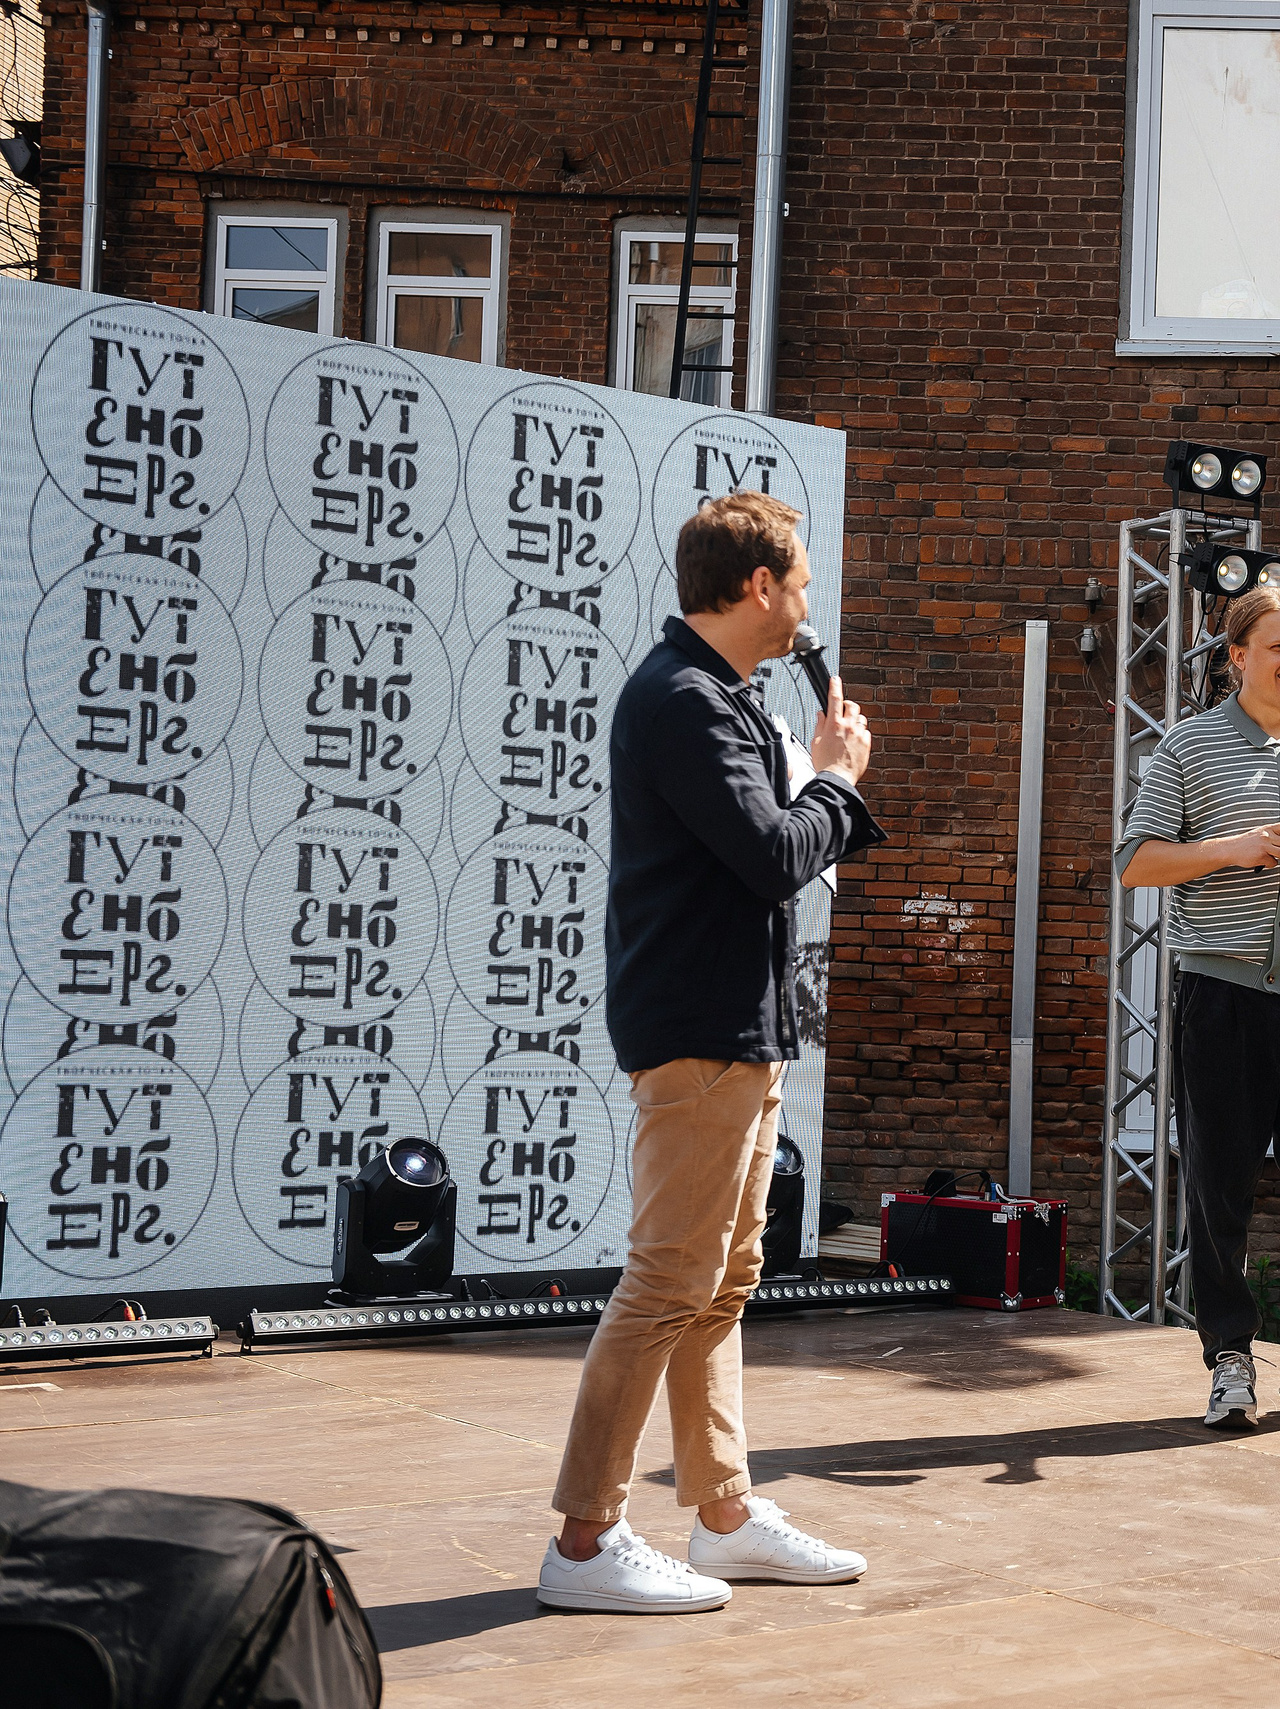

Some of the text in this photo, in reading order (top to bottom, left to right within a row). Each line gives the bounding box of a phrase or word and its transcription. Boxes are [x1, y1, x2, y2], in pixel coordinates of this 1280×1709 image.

[88, 336, 205, 400] ГУТ
[316, 375, 419, 434] ГУТ
[511, 412, 604, 468] ГУТ
[693, 444, 777, 494] ГУТ
[83, 586, 198, 644] ГУТ
[309, 612, 413, 666] ГУТ
[506, 638, 598, 690] ГУТ
[64, 829, 183, 884] ГУТ
[294, 842, 399, 893] ГУТ
[492, 857, 585, 906] ГУТ
[56, 1083, 173, 1138] ГУТ
[285, 1072, 390, 1123] ГУТ
[484, 1086, 578, 1134] ГУТ
